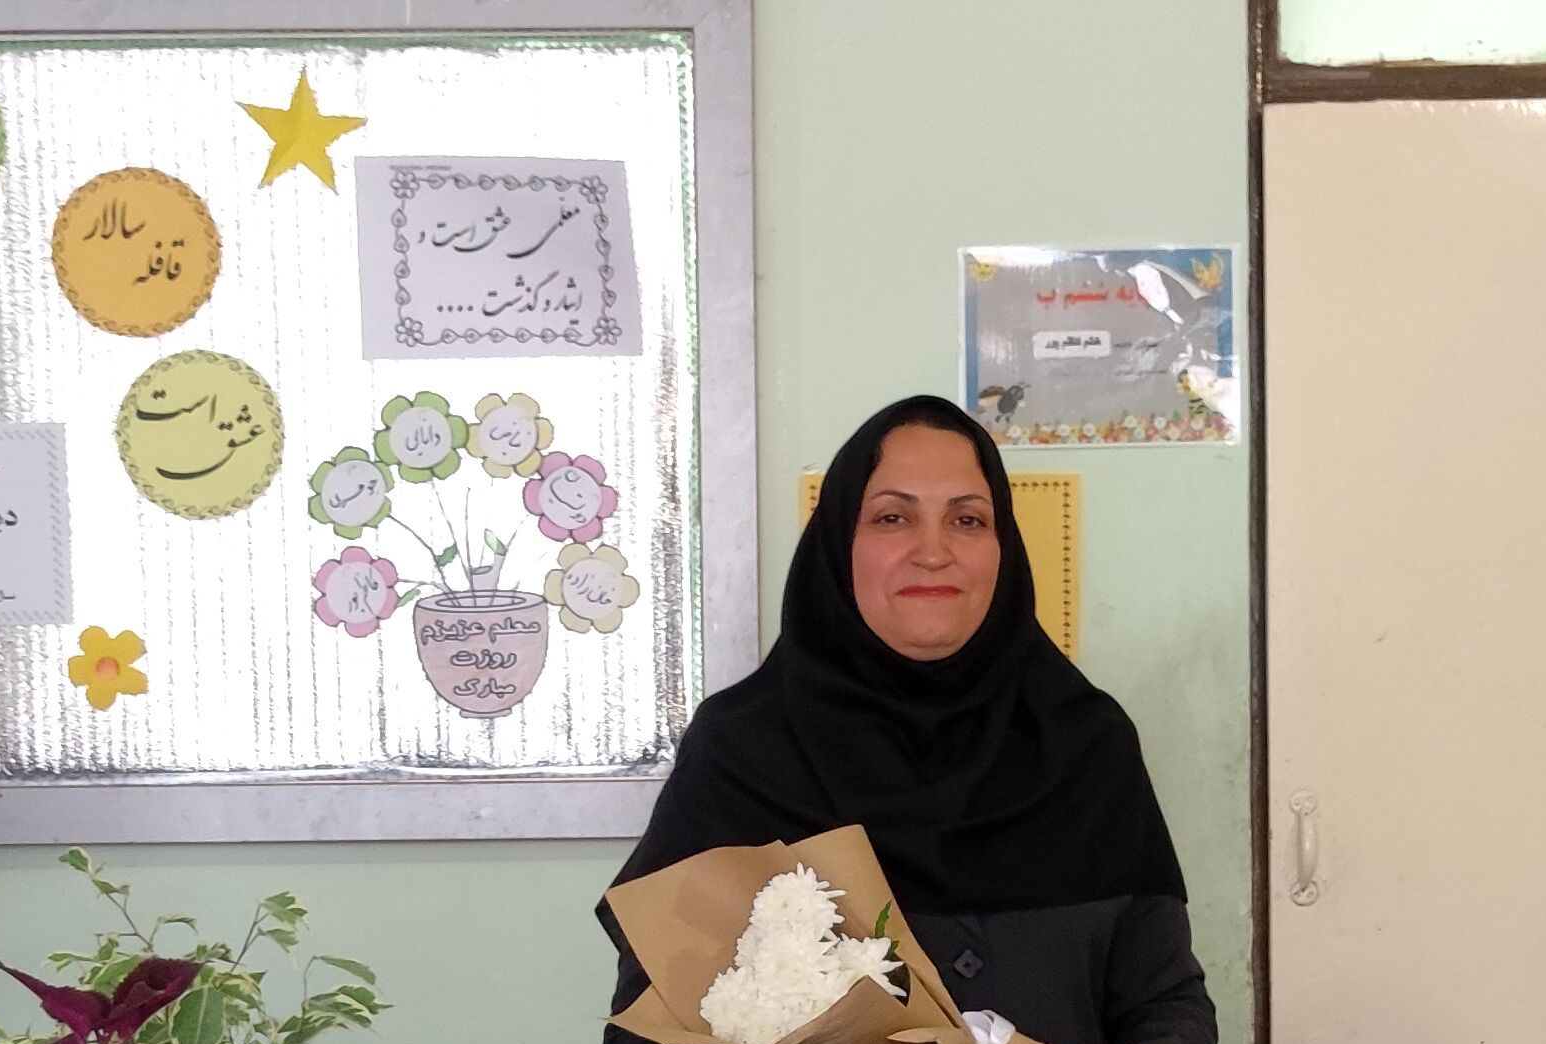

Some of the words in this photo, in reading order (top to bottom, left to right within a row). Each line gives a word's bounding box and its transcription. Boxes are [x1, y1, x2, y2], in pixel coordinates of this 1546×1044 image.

[82, 197, 147, 241] سالار
[431, 222, 477, 248] است
[453, 205, 512, 253] عشق
[416, 230, 427, 245] و
[133, 238, 186, 287] قافله
[482, 269, 561, 317] گذشت
[554, 276, 583, 326] ایثار
[136, 388, 218, 422] است
[155, 404, 266, 480] عشق
[420, 620, 486, 646] عزیزم
[488, 617, 542, 644] معلم
[449, 649, 518, 670] روزت
[452, 677, 517, 699] مبارک
